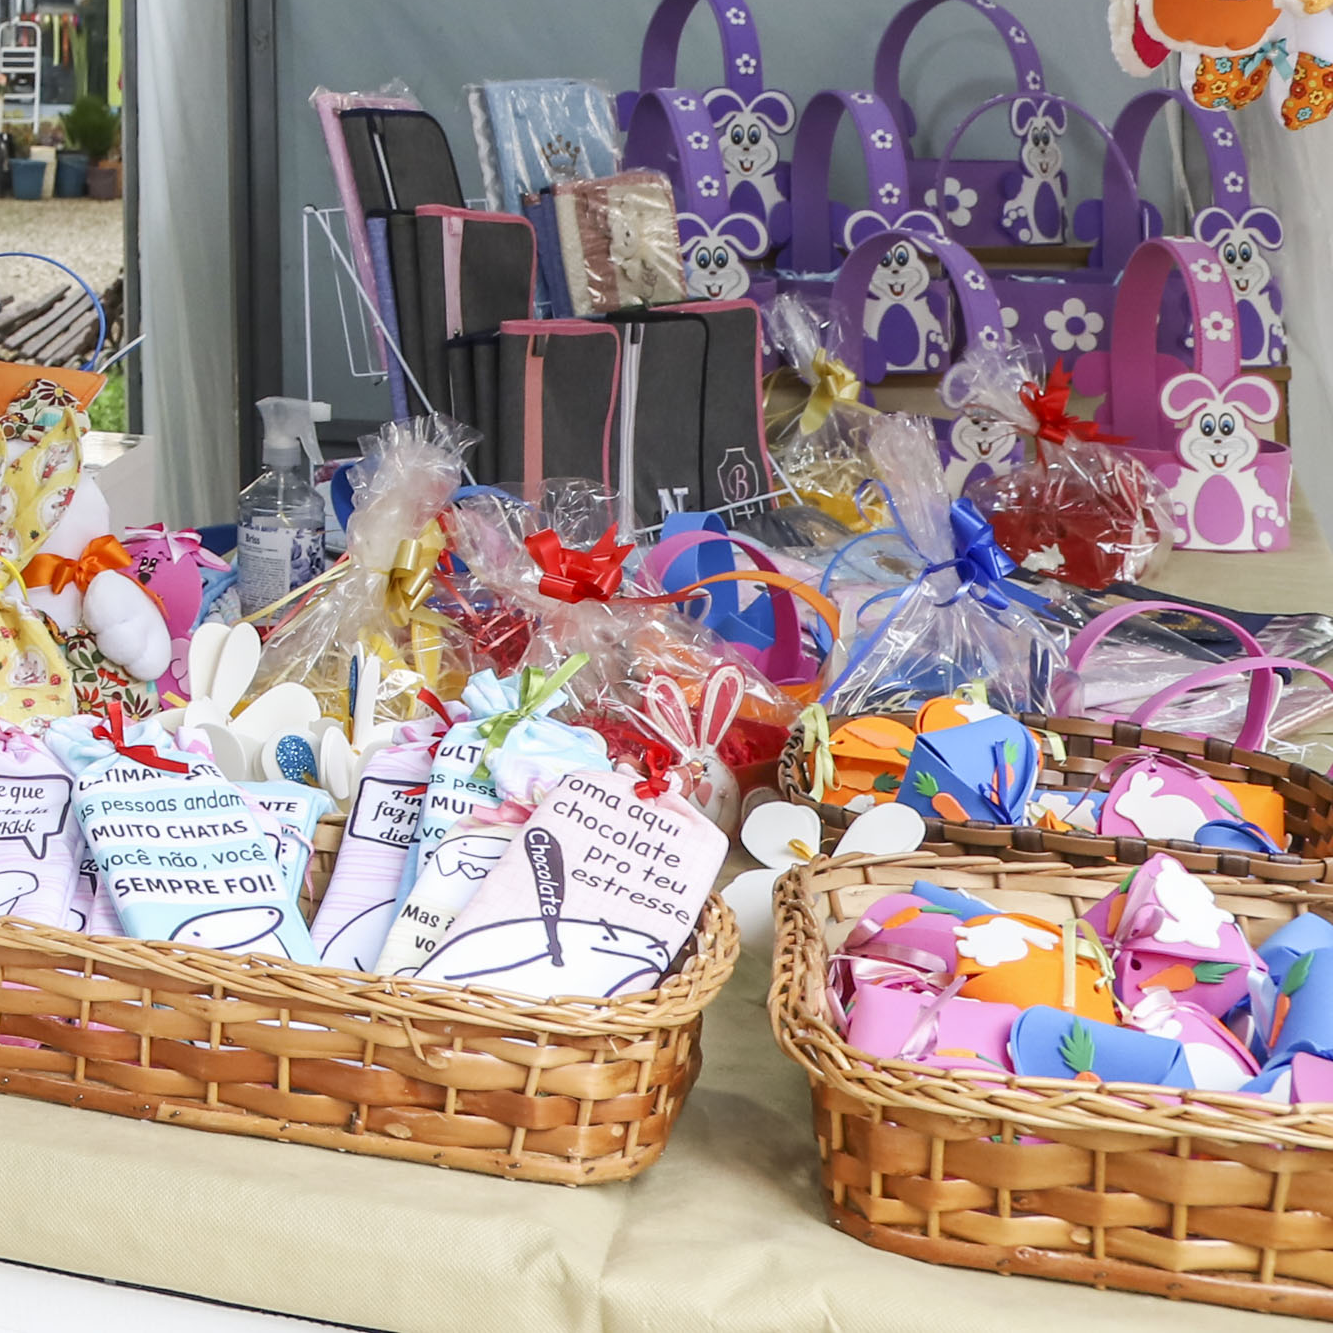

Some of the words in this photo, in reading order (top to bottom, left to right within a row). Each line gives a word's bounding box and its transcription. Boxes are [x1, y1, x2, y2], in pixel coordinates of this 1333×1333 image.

[727, 464, 749, 501] B
[10, 786, 46, 804] que
[101, 797, 178, 816] pessoas
[184, 789, 246, 811] andam
[557, 774, 621, 811] Toma
[628, 804, 681, 838] aqui
[25, 807, 50, 815] da
[371, 801, 406, 824] faz
[91, 824, 161, 842] MUITO
[166, 820, 249, 840] CHATAS
[553, 801, 681, 869] chocolate
[100, 849, 152, 873] você
[212, 843, 268, 863] você
[583, 845, 632, 874] pro
[643, 866, 688, 896] teu
[114, 875, 221, 898] SEMPRE
[224, 874, 277, 894] FOI!
[527, 830, 562, 917] Chocolate
[571, 868, 691, 926] estresse
[400, 904, 440, 928] Mas
